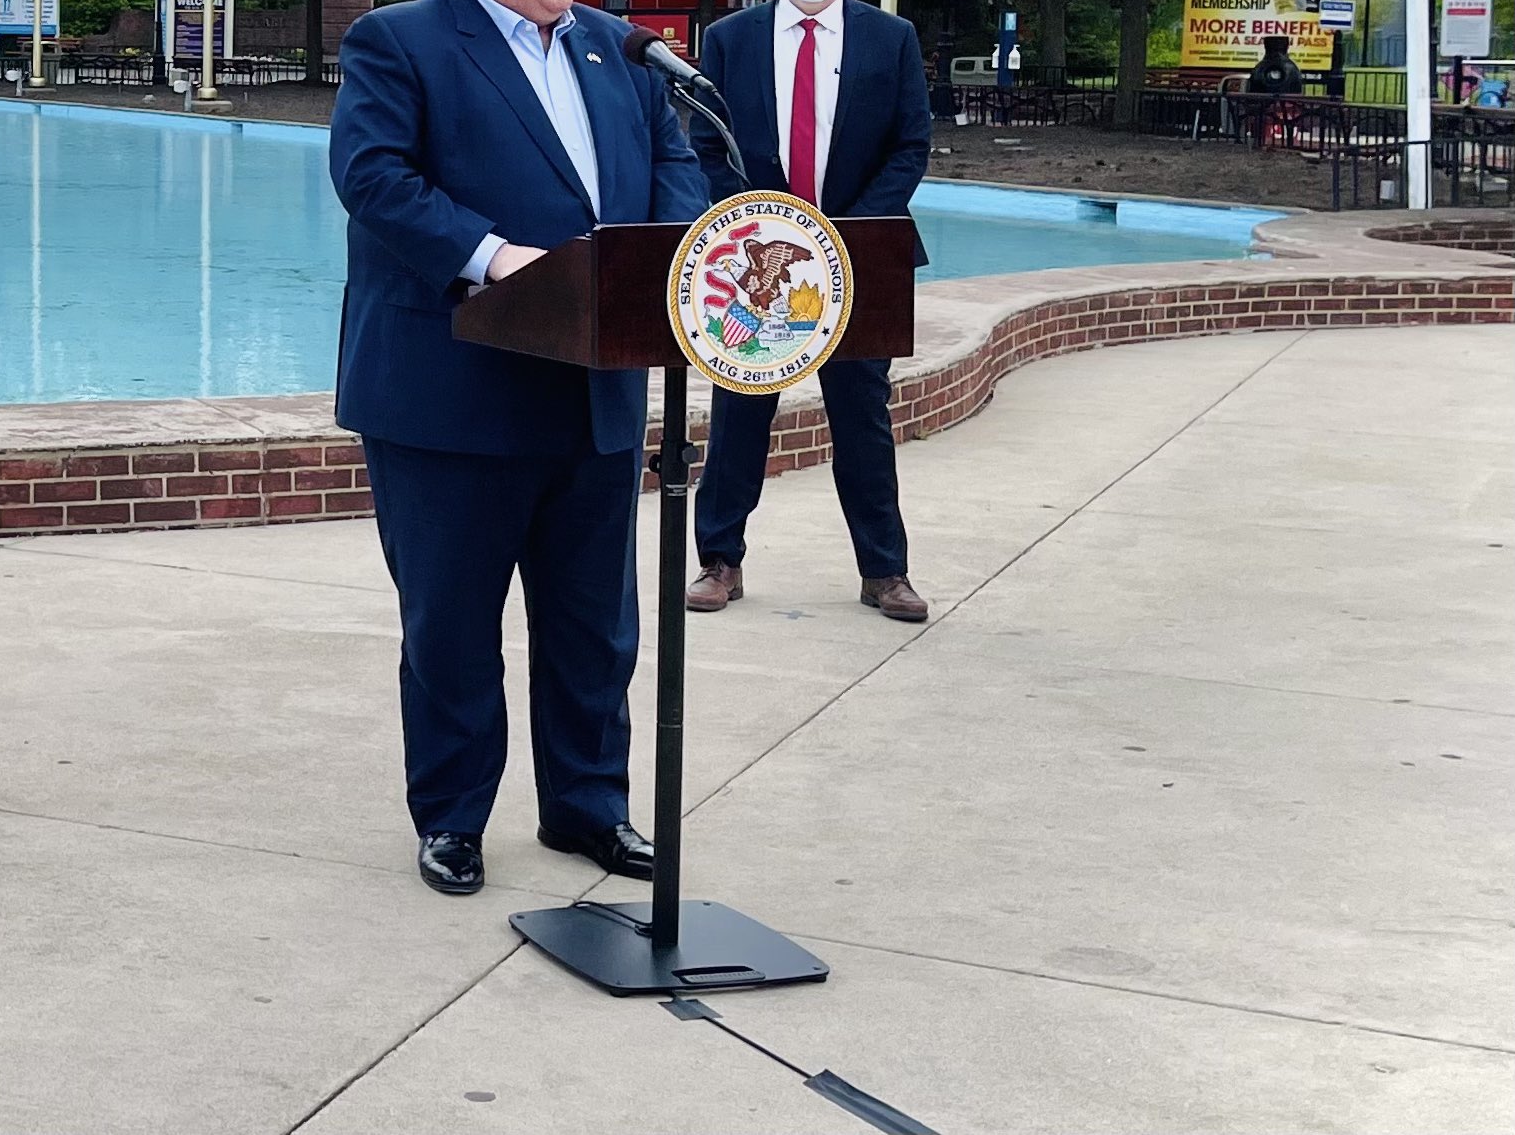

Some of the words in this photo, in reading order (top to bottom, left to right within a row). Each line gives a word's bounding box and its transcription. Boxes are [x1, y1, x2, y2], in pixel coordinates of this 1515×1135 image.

[1190, 18, 1246, 34] MORE
[1194, 34, 1228, 45] THAN
[1231, 35, 1241, 45] A
[1244, 35, 1293, 46] SEAN
[1297, 37, 1327, 47] PASS
[681, 259, 696, 304] SEAL
[693, 232, 708, 254] OF
[709, 208, 742, 234] THE
[745, 203, 794, 219] STATE
[796, 214, 816, 229] OF
[814, 230, 842, 304] ILLINOIS
[779, 353, 811, 378] 1818
